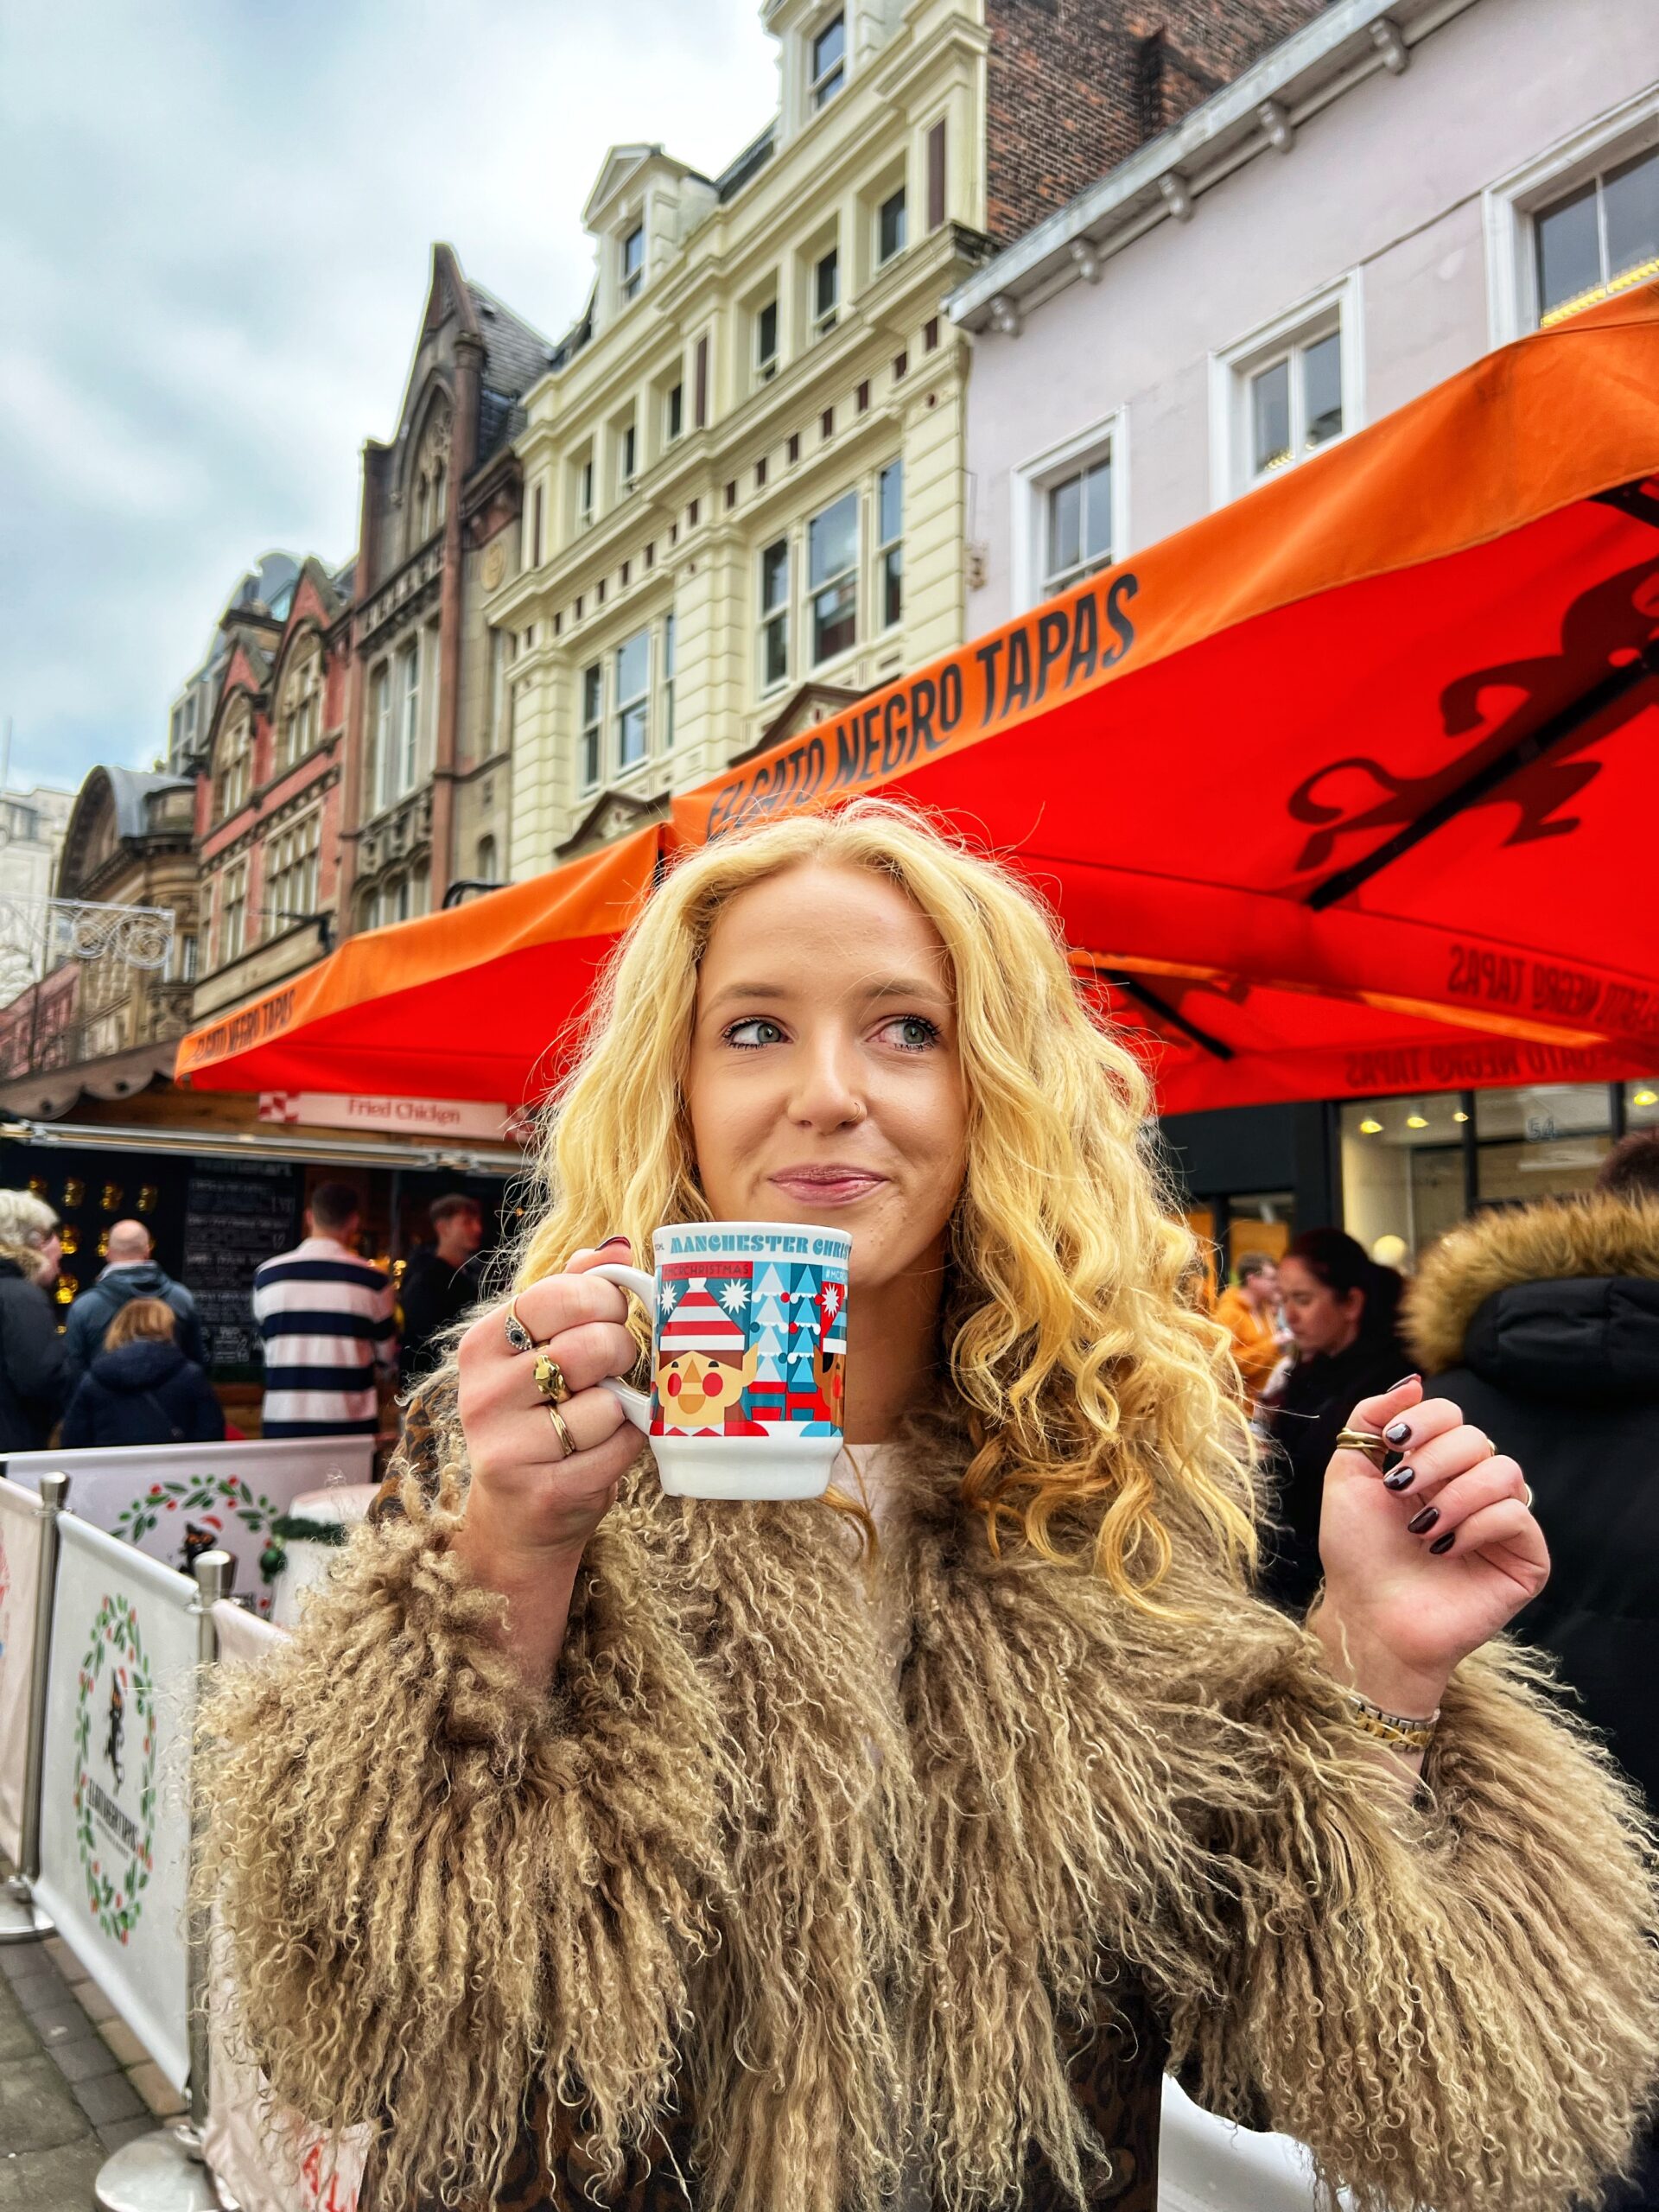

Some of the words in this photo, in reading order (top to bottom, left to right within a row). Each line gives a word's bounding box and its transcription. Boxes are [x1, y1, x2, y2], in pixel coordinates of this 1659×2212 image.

[734, 739, 824, 828] GATO
[826, 664, 963, 790] NEGRO
[976, 573, 1138, 728] TAPAS
[348, 1098, 390, 1116] Fried
[395, 1100, 461, 1126] Chicken
[671, 1235, 809, 1254] MANCHESTER
